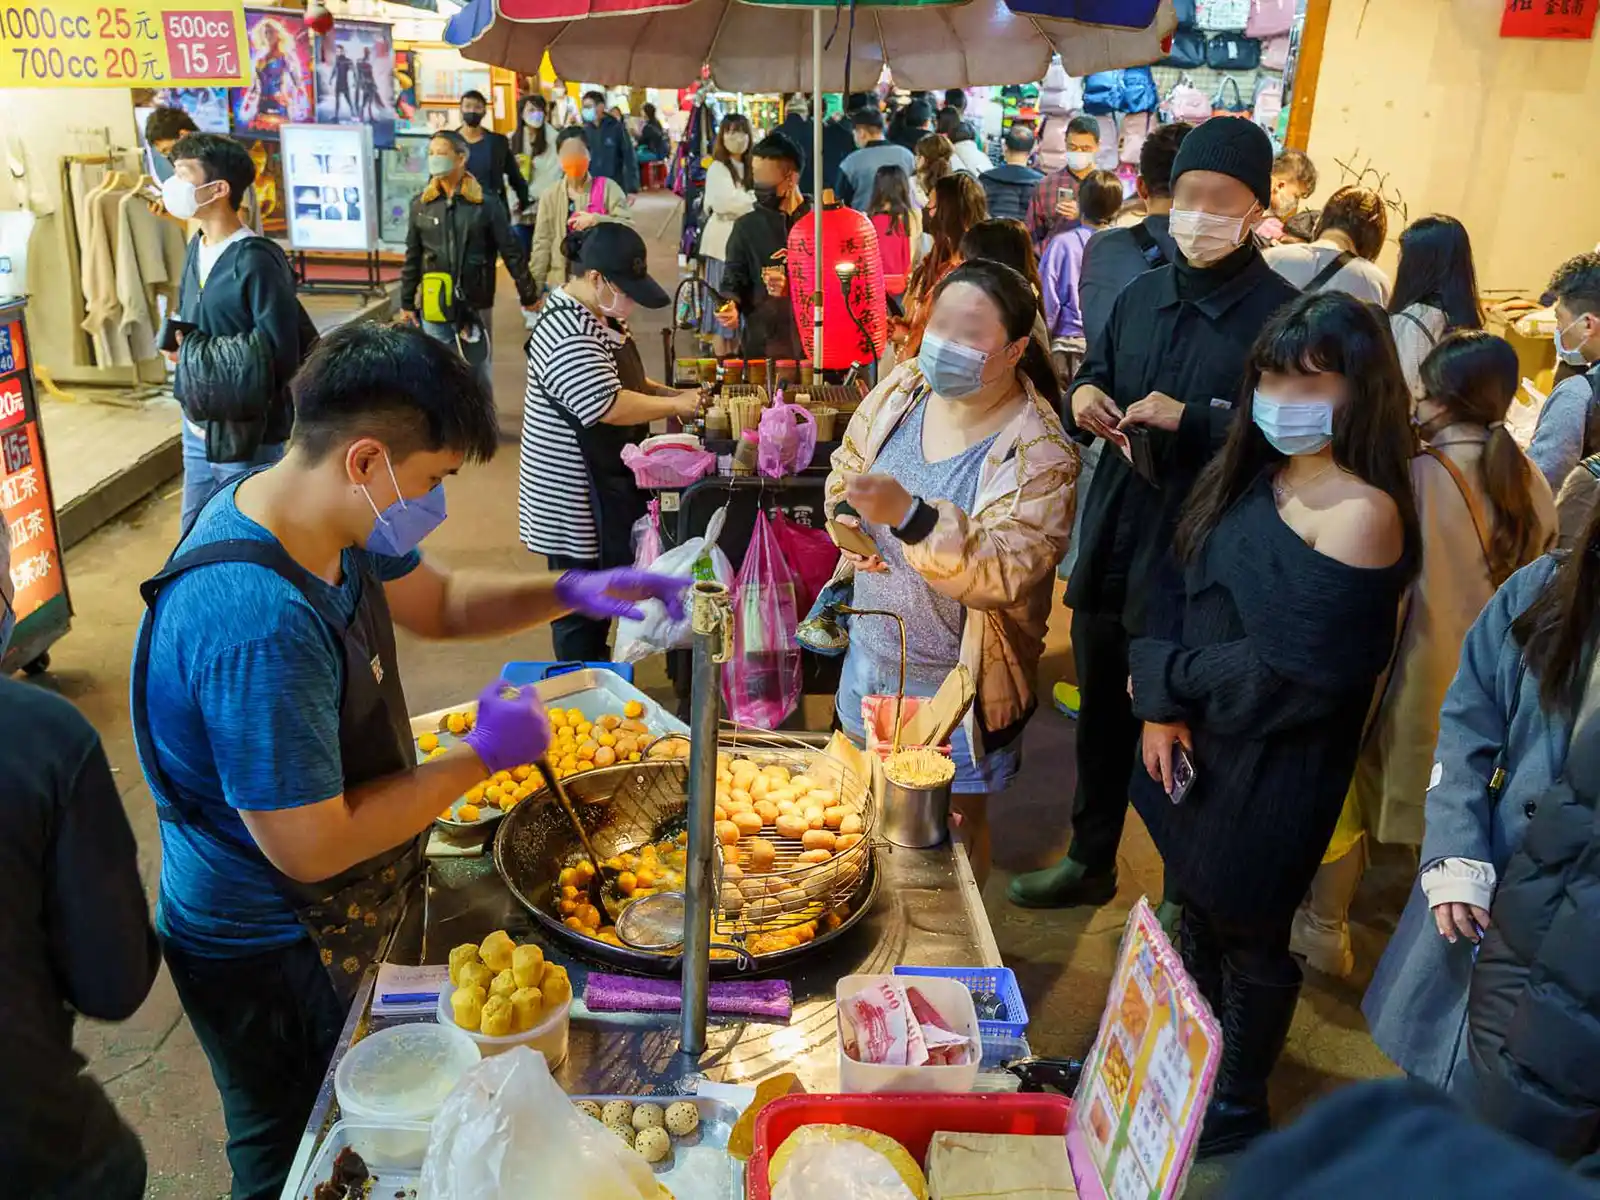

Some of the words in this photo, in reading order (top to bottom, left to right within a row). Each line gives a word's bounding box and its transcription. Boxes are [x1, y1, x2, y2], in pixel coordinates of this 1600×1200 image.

[0, 7, 91, 40] 1000cc
[97, 7, 158, 40] 25元
[168, 15, 230, 39] 500cc
[12, 47, 98, 79] 700cc
[104, 47, 164, 80] 20元
[177, 43, 236, 74] 15元
